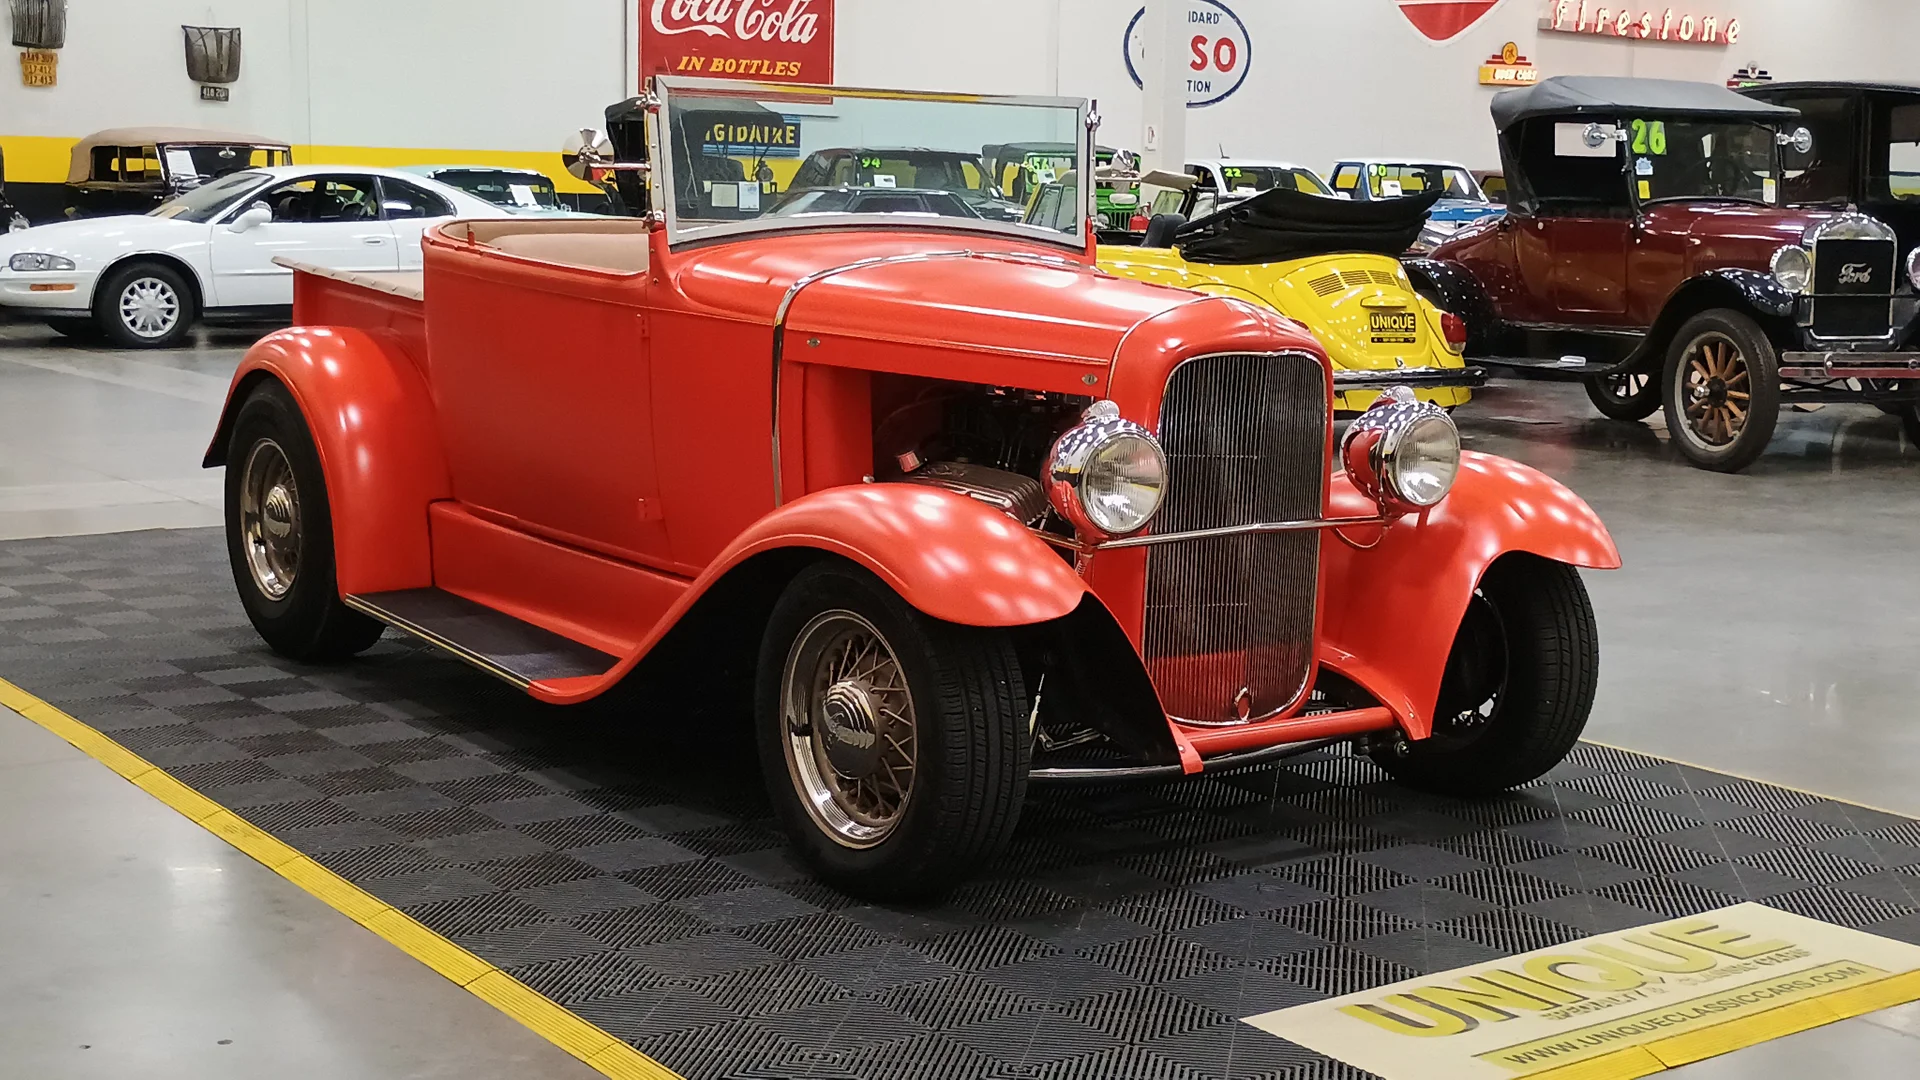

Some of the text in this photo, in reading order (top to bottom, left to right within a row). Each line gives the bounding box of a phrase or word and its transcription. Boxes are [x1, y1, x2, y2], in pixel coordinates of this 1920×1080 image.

[1553, 0, 1741, 44] Firestone
[677, 56, 801, 77] IN BOTTLES
[1631, 118, 1667, 155] 26
[861, 156, 881, 169] 94
[1224, 167, 1242, 178] 22
[1838, 262, 1872, 284] Ford
[1371, 313, 1415, 329] UNIQUE
[1338, 919, 1797, 1037] UNIQUE
[1502, 965, 1866, 1065] WWW.UNIQUECLASSICCARS.COM
